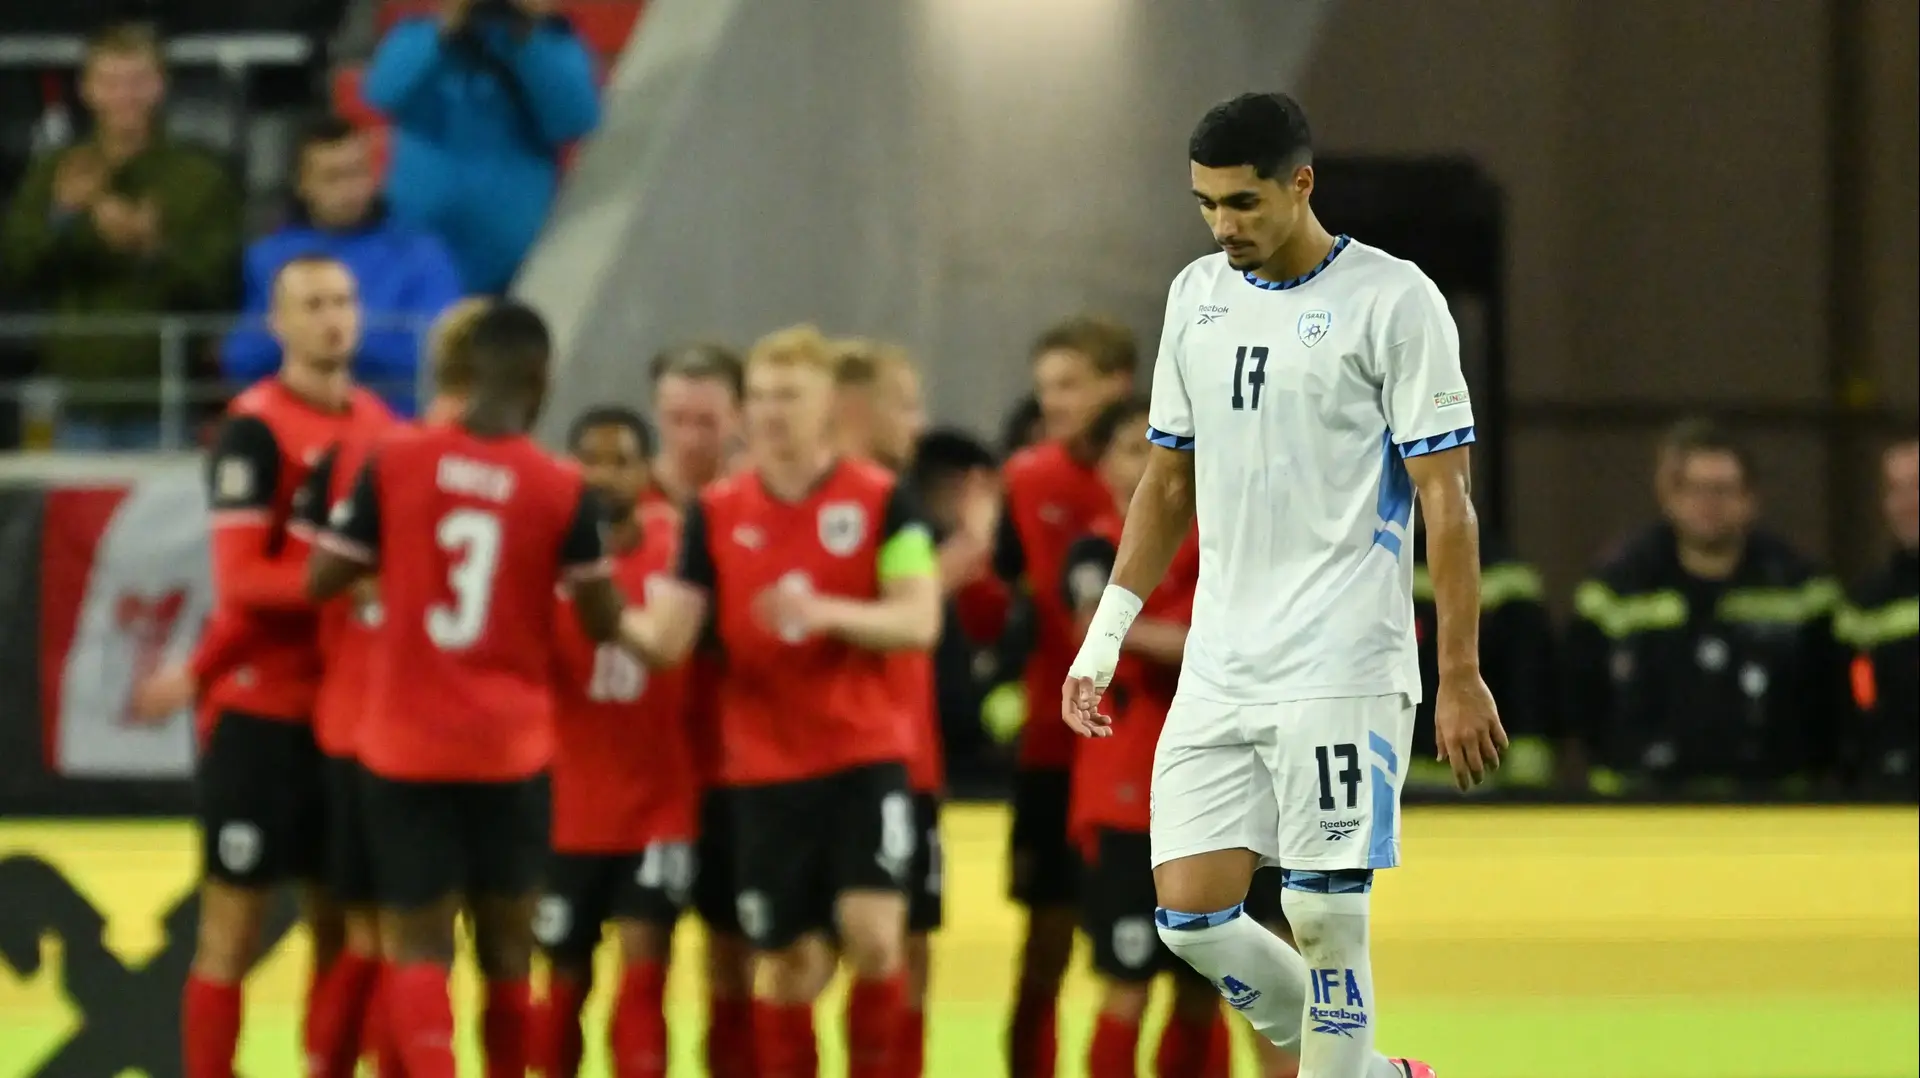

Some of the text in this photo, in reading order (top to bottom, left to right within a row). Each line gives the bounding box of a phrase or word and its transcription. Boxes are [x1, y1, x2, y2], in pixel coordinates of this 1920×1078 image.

[1199, 303, 1229, 314] Reebok
[1305, 312, 1326, 320] ISRAEL
[1231, 346, 1269, 411] 17
[425, 507, 501, 651] 3
[1315, 743, 1363, 811] 17
[1320, 819, 1360, 830] Reebok
[1309, 1006, 1368, 1025] Reebok
